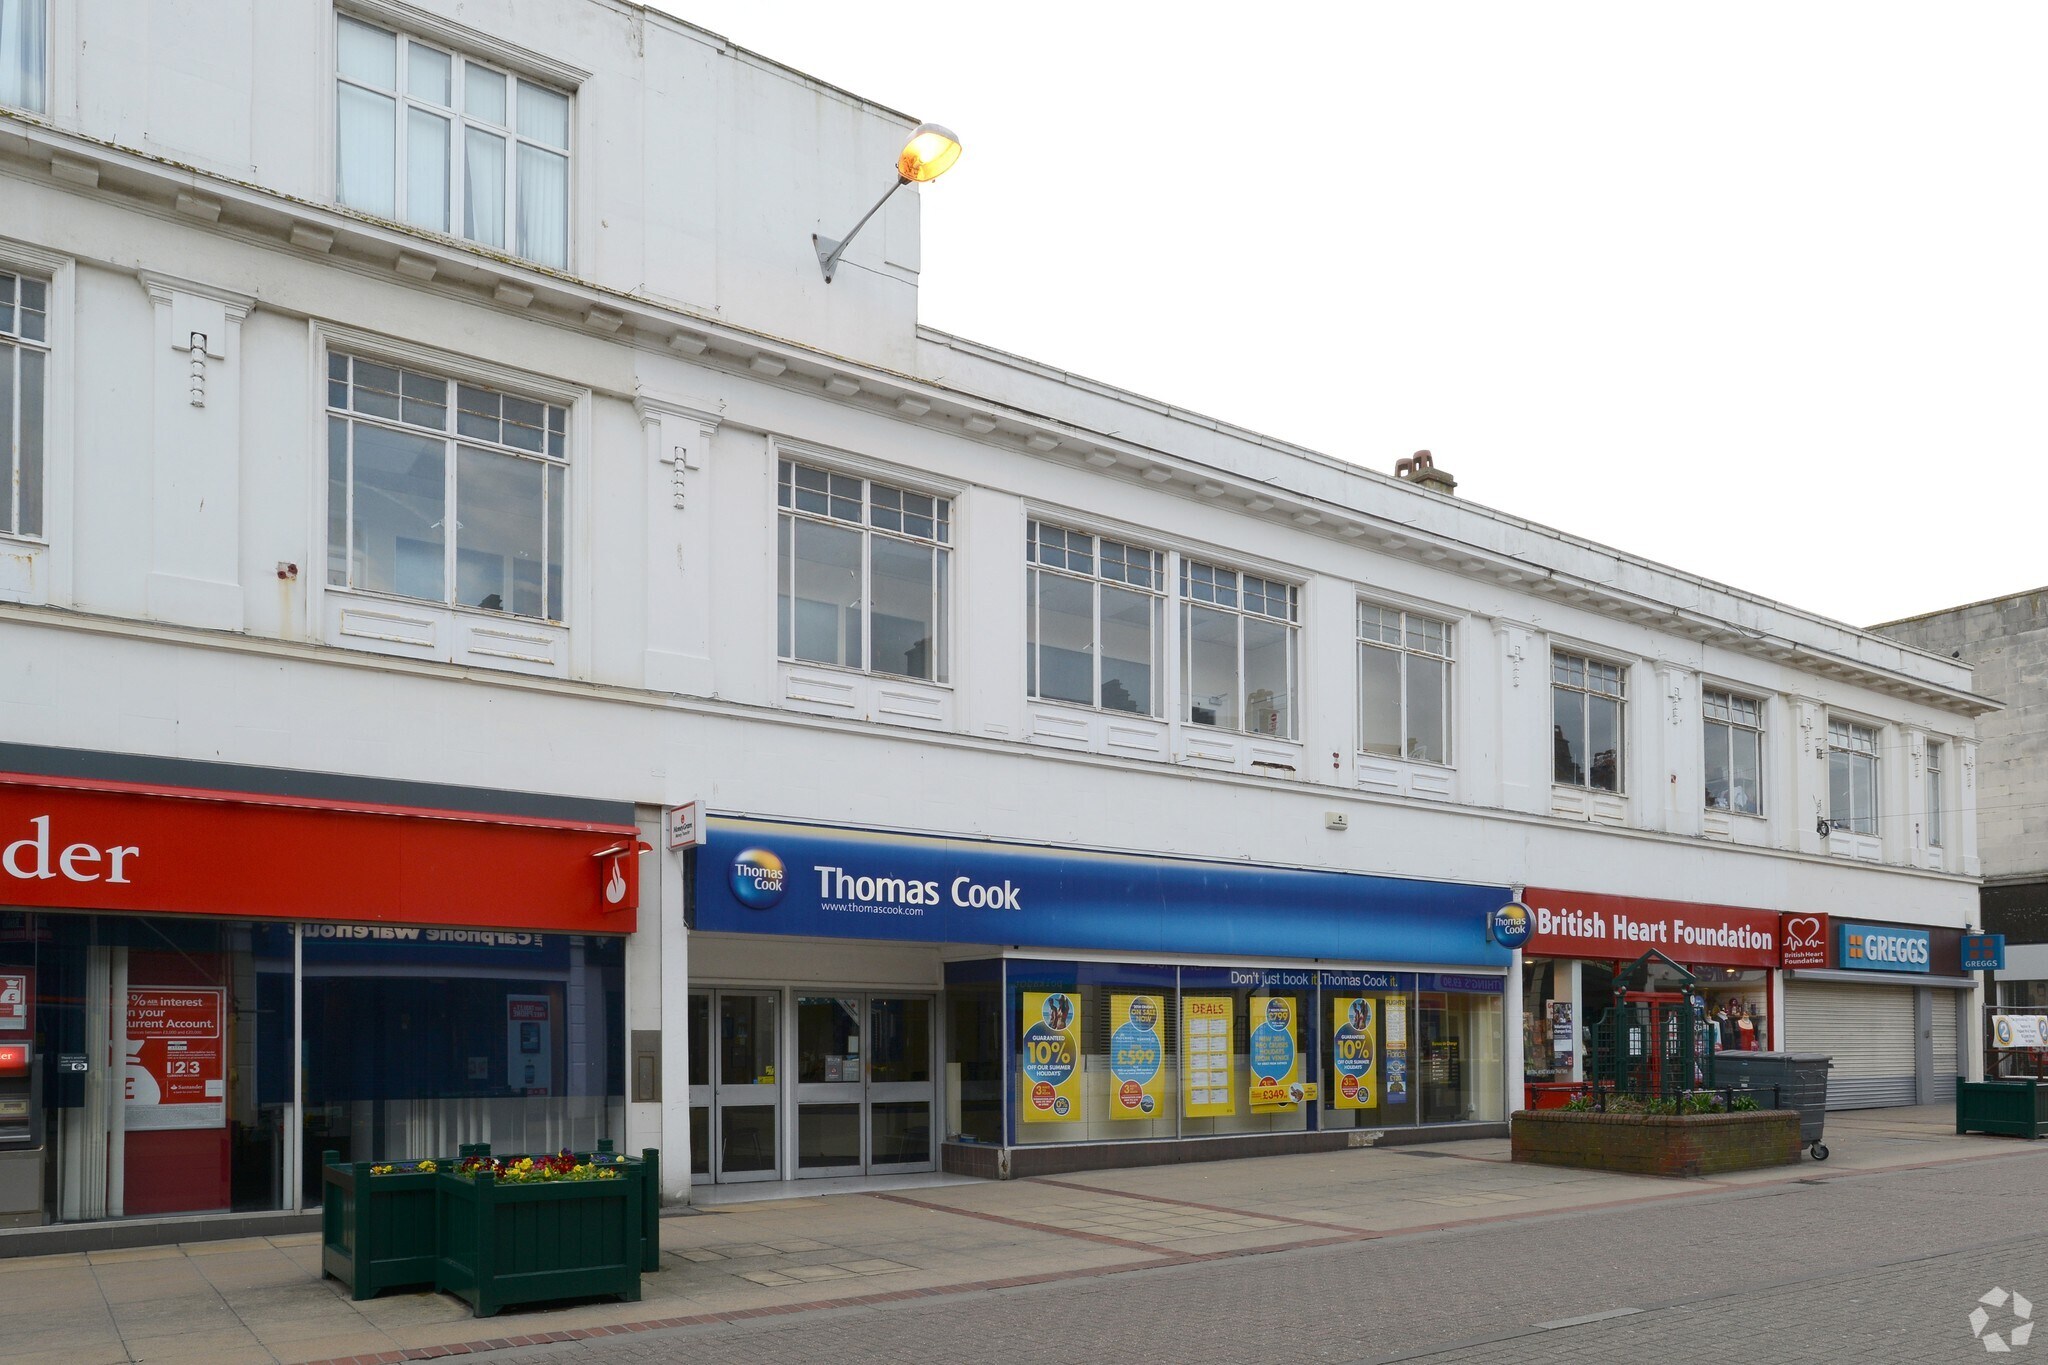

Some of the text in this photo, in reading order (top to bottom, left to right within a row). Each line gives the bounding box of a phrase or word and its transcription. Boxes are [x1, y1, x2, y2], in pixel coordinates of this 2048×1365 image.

[3, 816, 139, 883] der
[735, 864, 782, 879] Thomas
[754, 878, 782, 891] Cook
[814, 866, 1021, 910] Thomas Cook
[822, 902, 923, 916] www.thomascook.com
[1495, 918, 1526, 926] Thomas
[1505, 926, 1525, 934] Cook
[1538, 908, 1772, 950] British Heart Foundation
[1865, 935, 1927, 964] GREGGS
[1231, 971, 1259, 985] Don't
[1261, 972, 1280, 986] just
[1283, 972, 1309, 985] book
[1322, 975, 1361, 986] Thomas
[1363, 975, 1387, 986] Cook
[161, 997, 202, 1006] interest
[139, 1010, 165, 1018] your
[1192, 1004, 1224, 1014] DEALS
[1268, 1012, 1288, 1020] £799
[167, 1020, 214, 1028] Account.
[1028, 1042, 1071, 1064] 10%
[1338, 1040, 1369, 1059] 10%
[1117, 1050, 1155, 1065] £599
[1036, 1086, 1042, 1095] 3
[1124, 1085, 1129, 1093] 3
